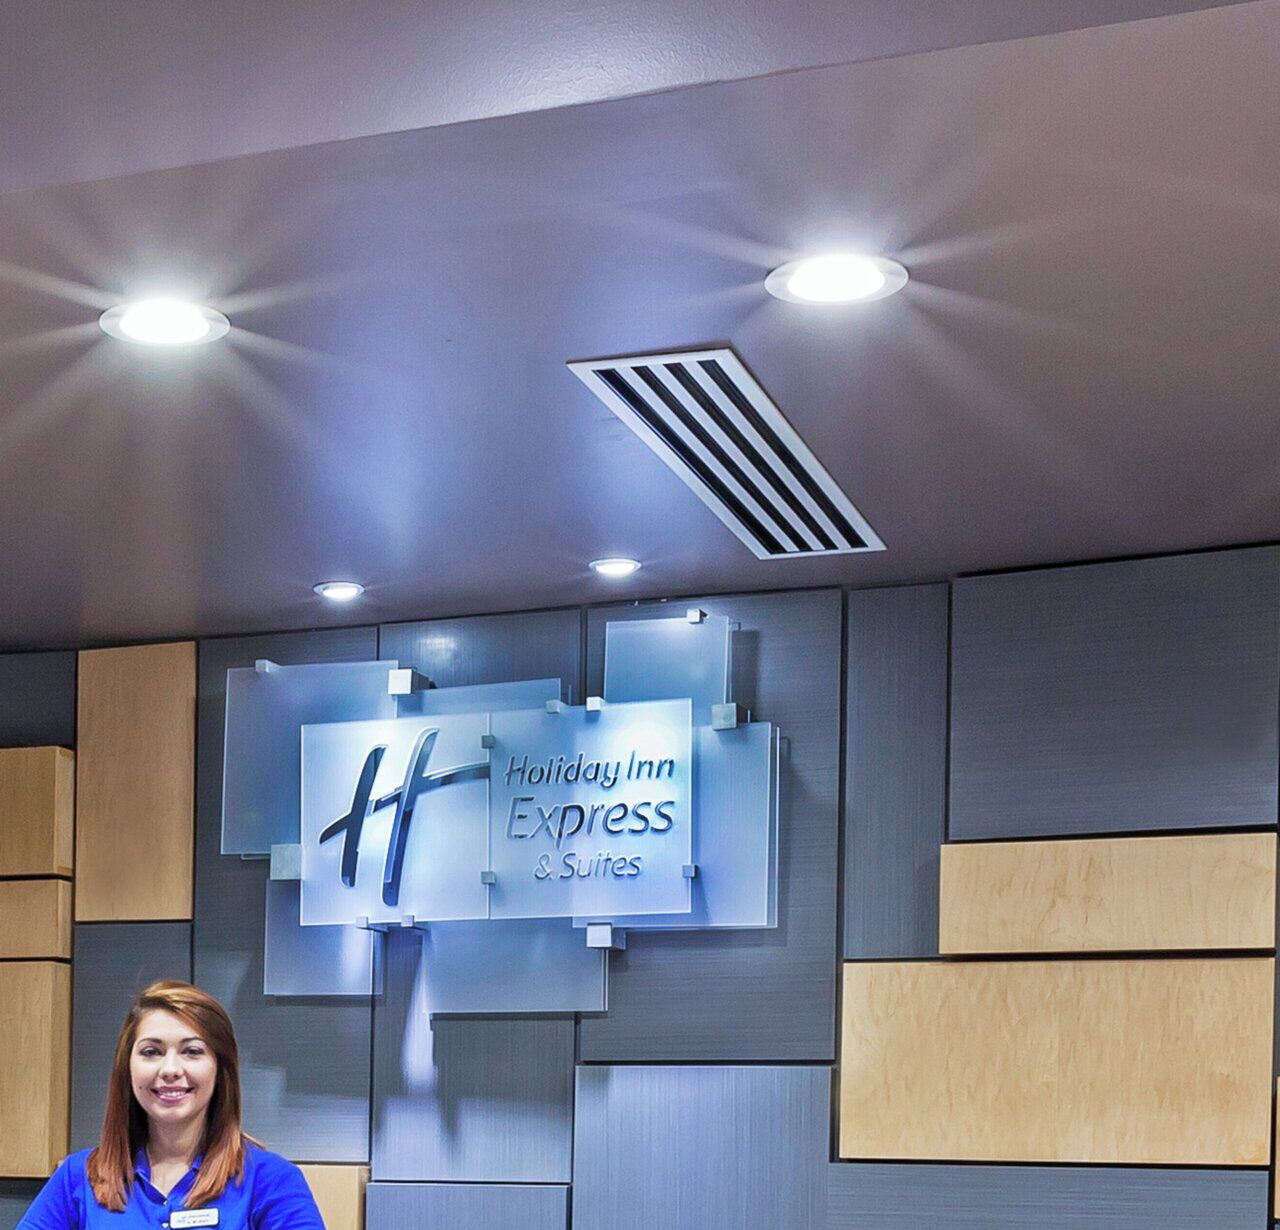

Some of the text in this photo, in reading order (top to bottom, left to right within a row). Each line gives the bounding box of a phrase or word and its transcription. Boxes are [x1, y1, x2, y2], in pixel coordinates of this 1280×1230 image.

[504, 750, 675, 789] Holiday Inn
[505, 795, 676, 849] Express
[533, 852, 642, 880] & Suites
